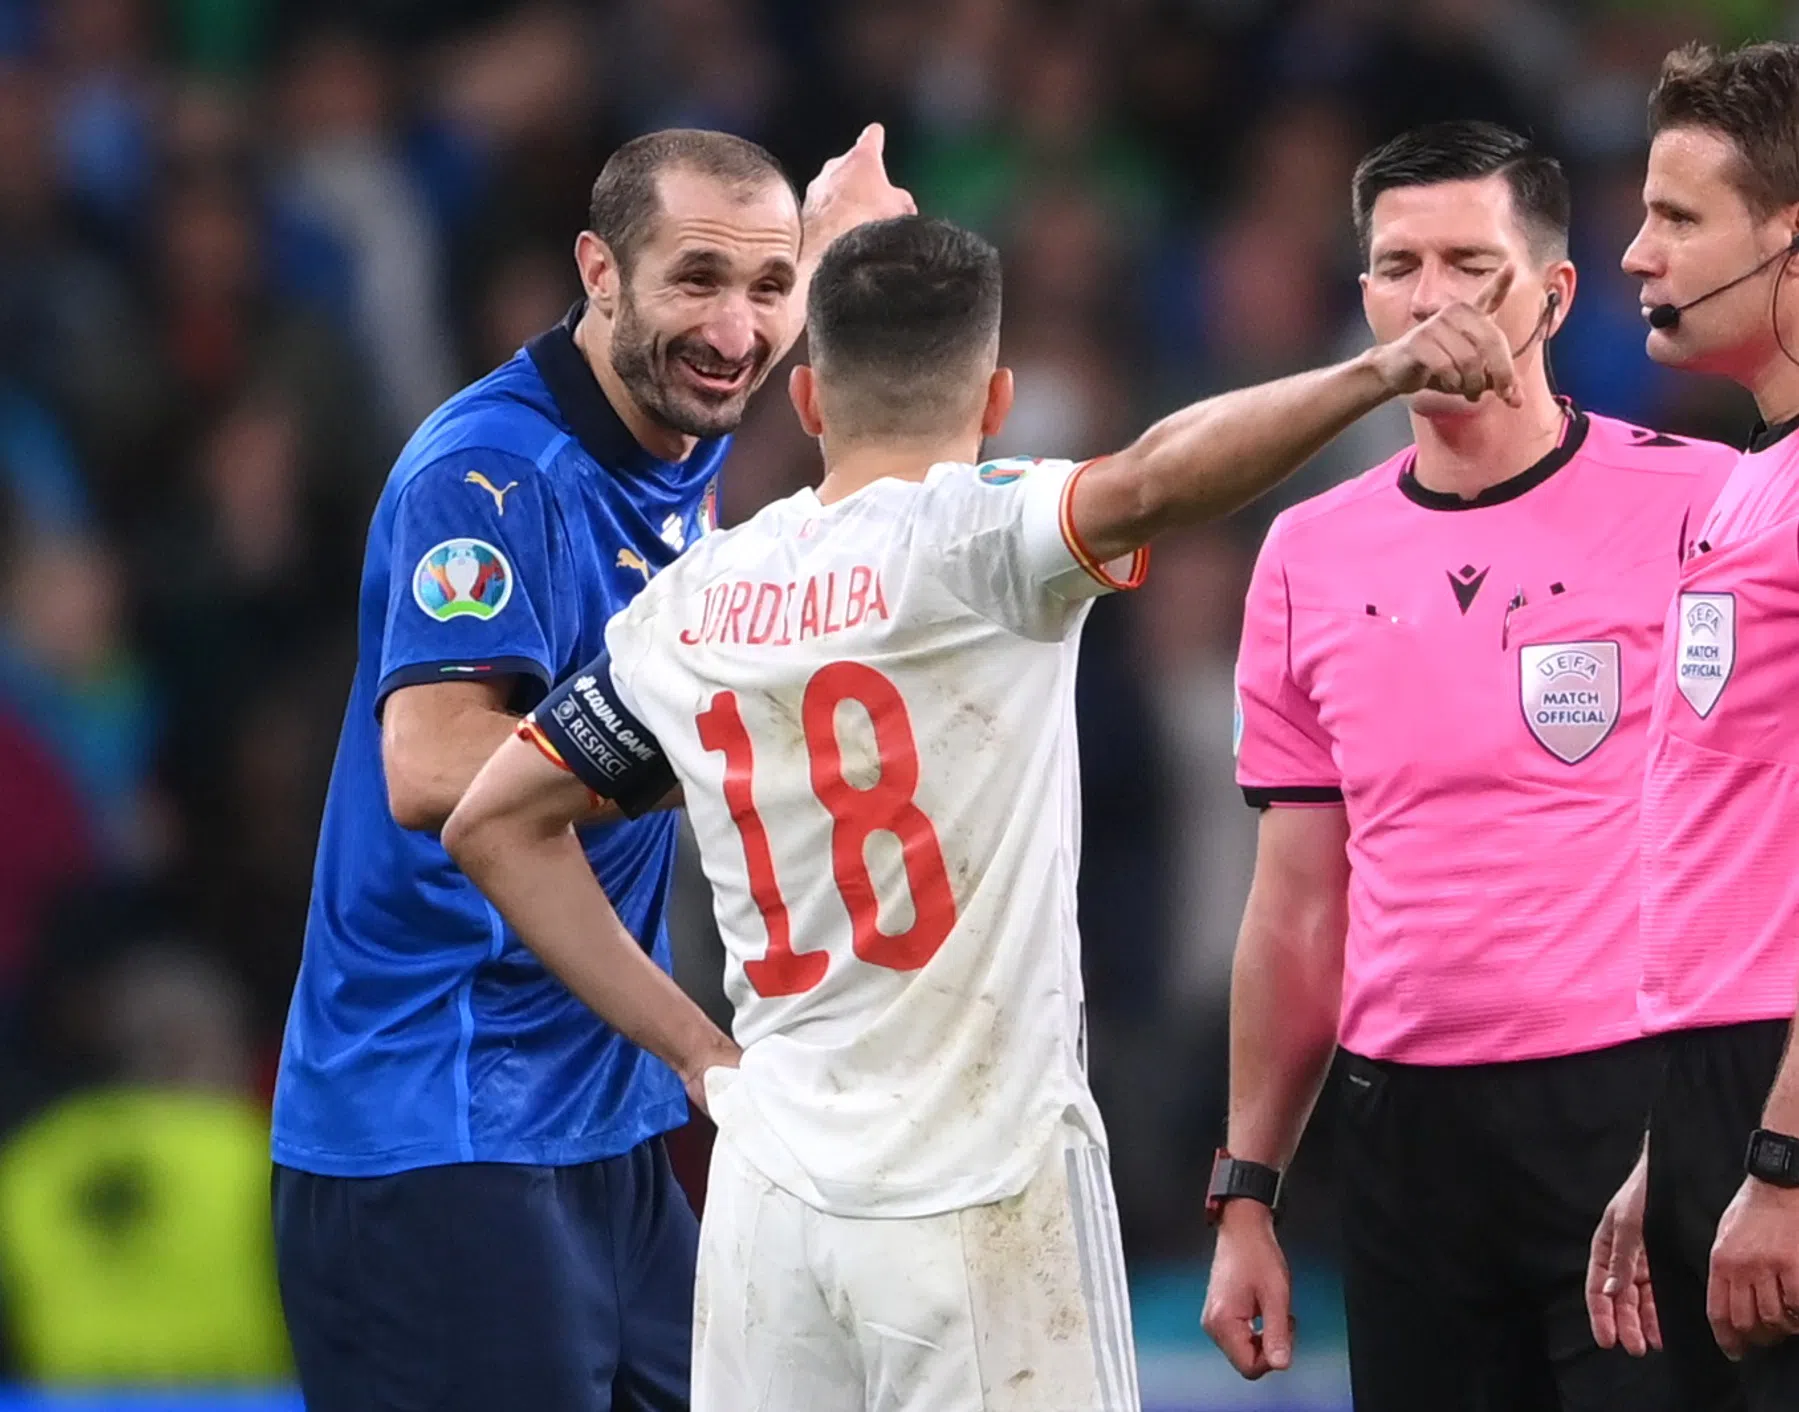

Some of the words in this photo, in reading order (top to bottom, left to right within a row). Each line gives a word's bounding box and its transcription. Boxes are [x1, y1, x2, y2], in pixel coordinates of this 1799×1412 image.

[679, 581, 796, 645] JORDI
[800, 565, 889, 641] ALBA
[1686, 608, 1719, 631] UEFA
[1687, 645, 1718, 658] MATCH
[1540, 656, 1597, 677] UEFA
[1681, 663, 1722, 677] OFFICIAL
[1543, 692, 1599, 705] MATCH
[1536, 710, 1606, 724] OFFICIAL
[569, 720, 628, 775] RESPECT
[695, 661, 955, 998] 18
